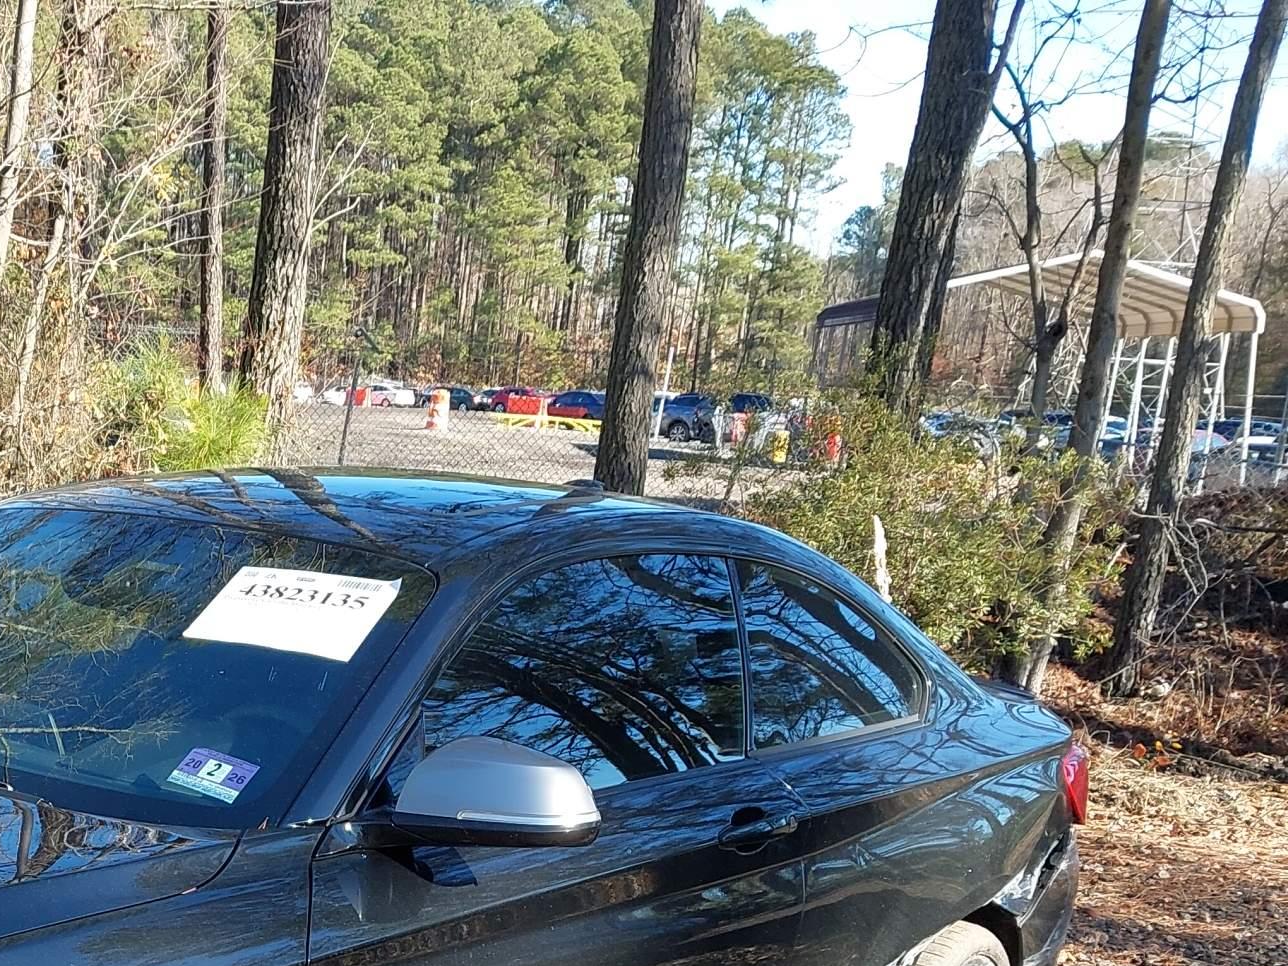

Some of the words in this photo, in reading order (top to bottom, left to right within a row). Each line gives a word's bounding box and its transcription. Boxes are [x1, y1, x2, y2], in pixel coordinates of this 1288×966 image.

[240, 584, 369, 609] 43823135
[184, 758, 203, 769] 20
[206, 763, 222, 776] 2
[228, 773, 247, 785] 26
